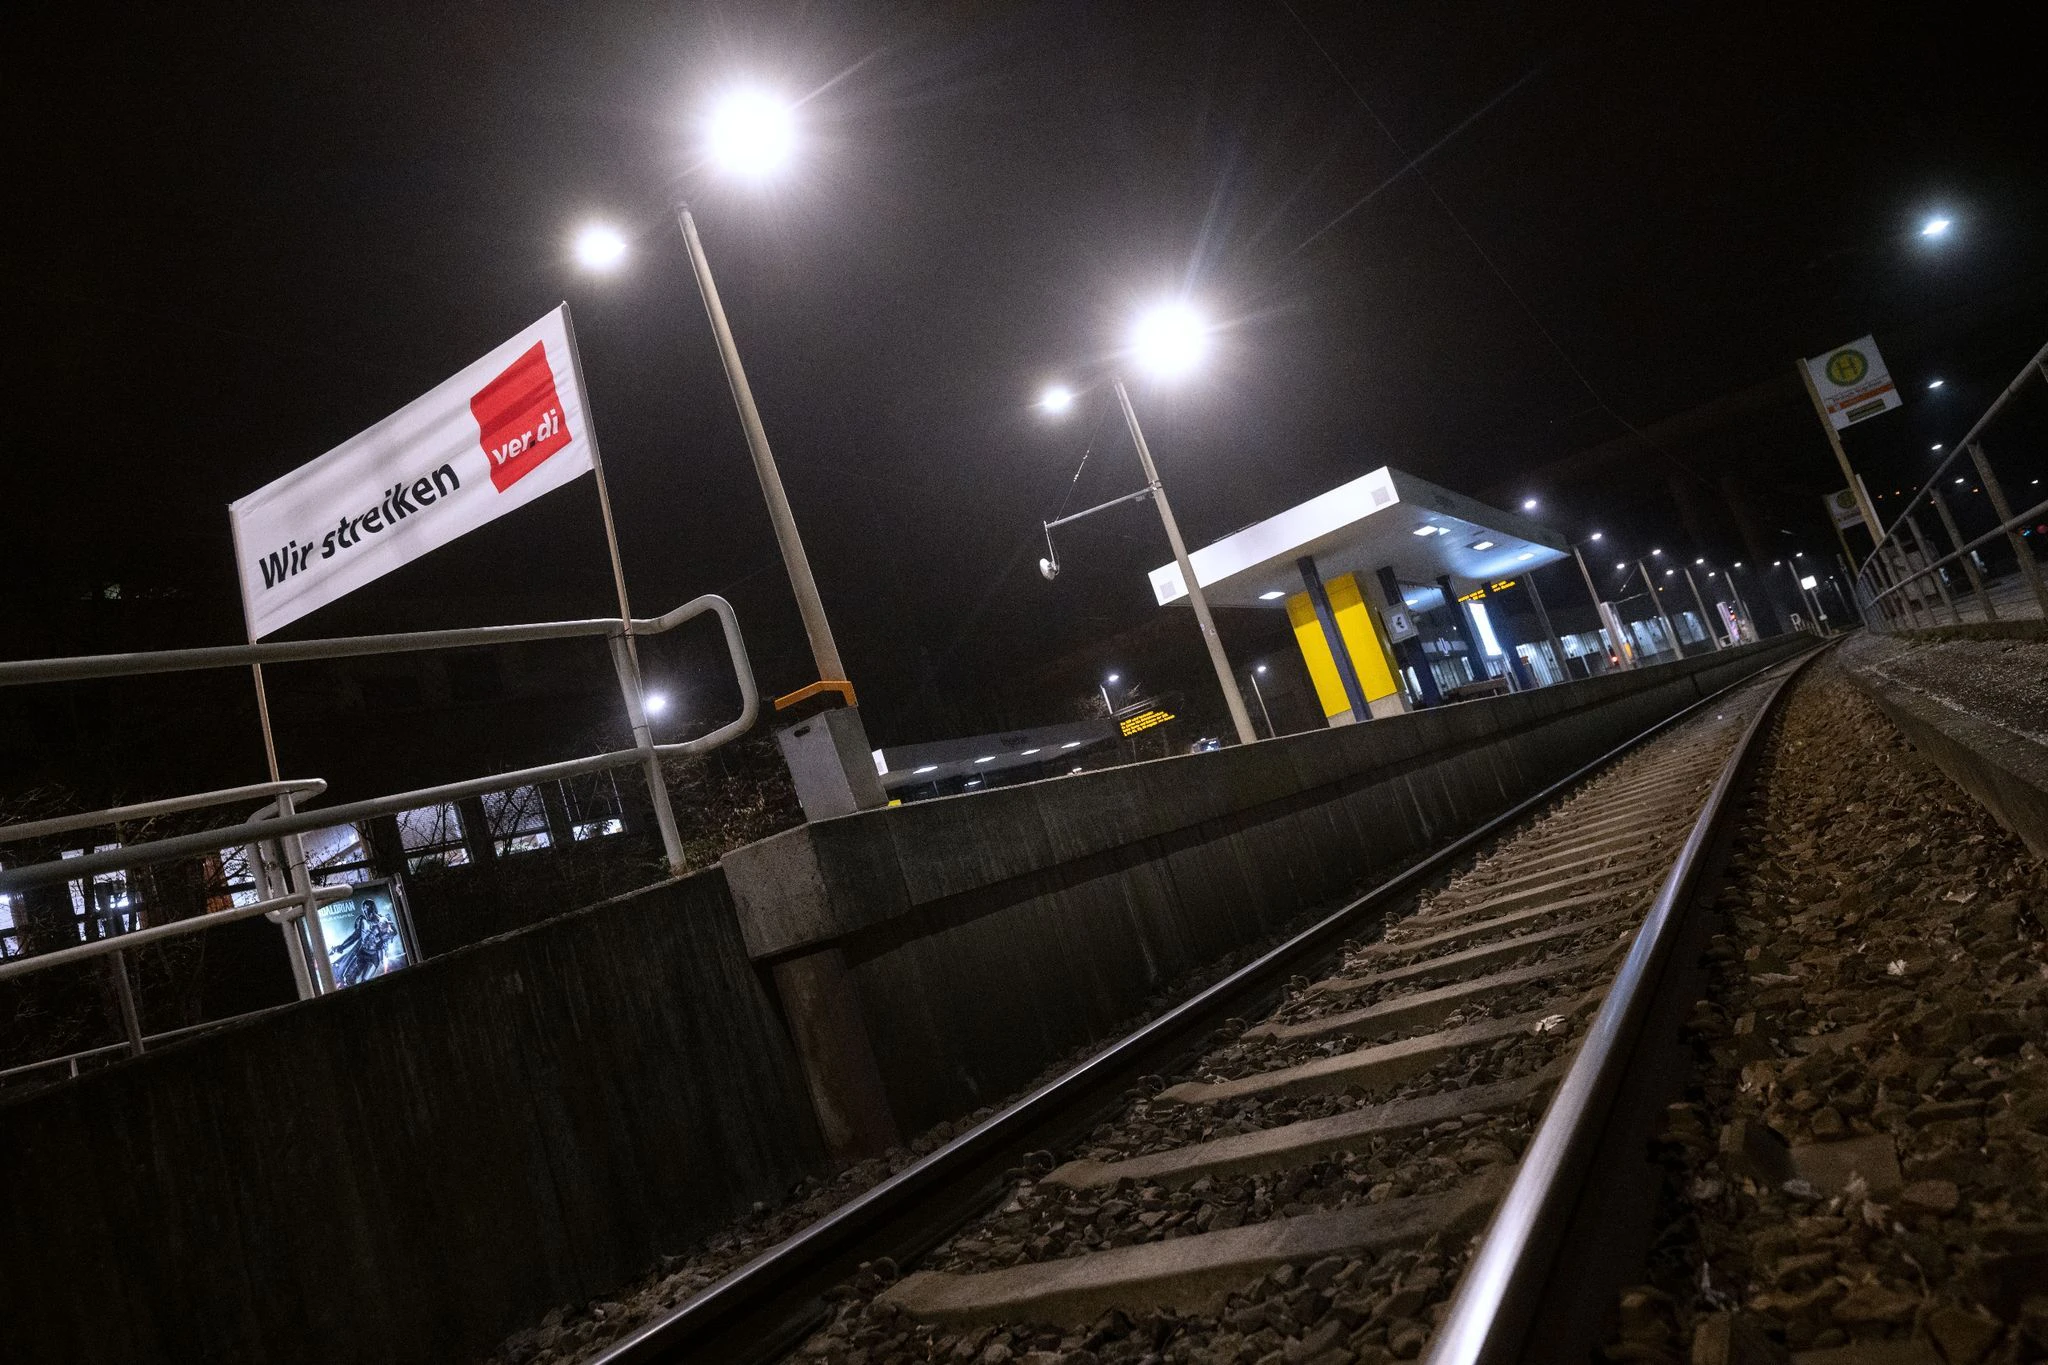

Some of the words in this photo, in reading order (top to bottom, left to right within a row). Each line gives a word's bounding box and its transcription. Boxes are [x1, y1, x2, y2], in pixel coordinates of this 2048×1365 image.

[491, 408, 560, 466] ver.di
[258, 540, 314, 590] Wir
[321, 463, 462, 560] streiken
